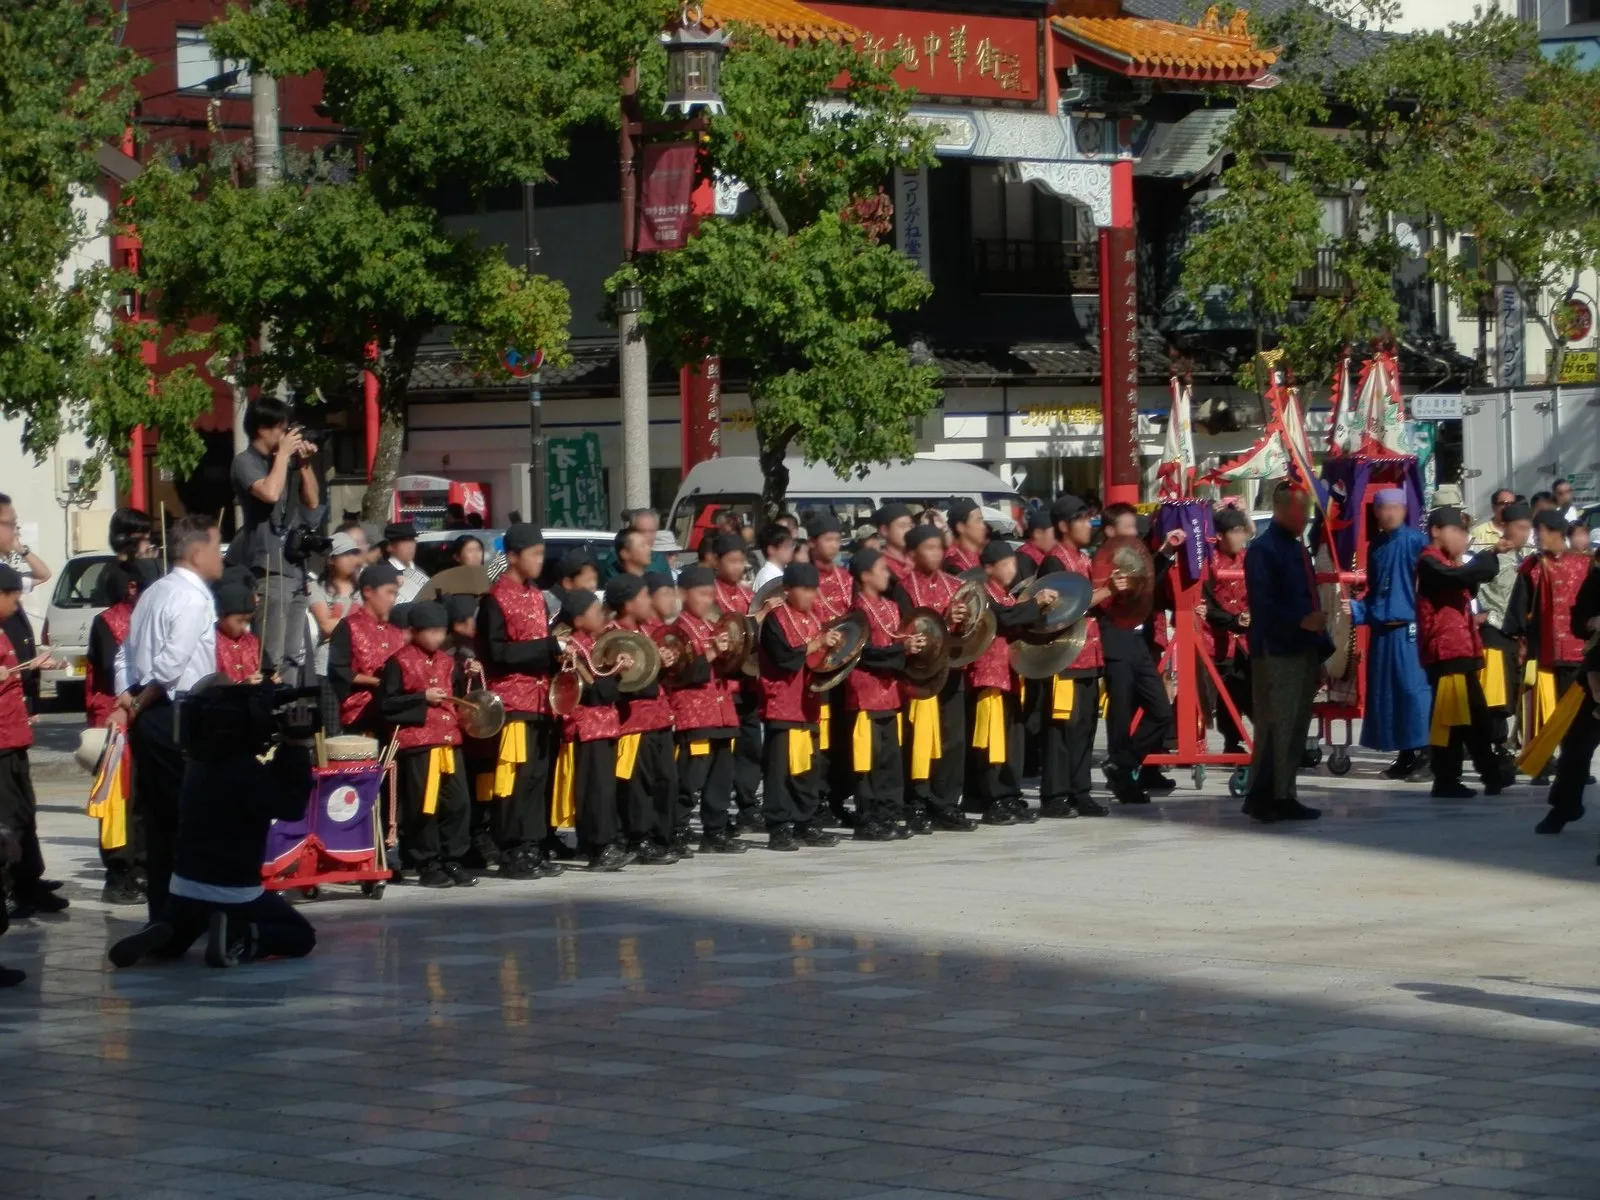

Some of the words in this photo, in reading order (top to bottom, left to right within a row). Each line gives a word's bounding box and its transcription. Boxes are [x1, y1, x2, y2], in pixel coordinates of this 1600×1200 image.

[862, 24, 1000, 84] 新地中華街
[903, 180, 922, 270] つりがね堂
